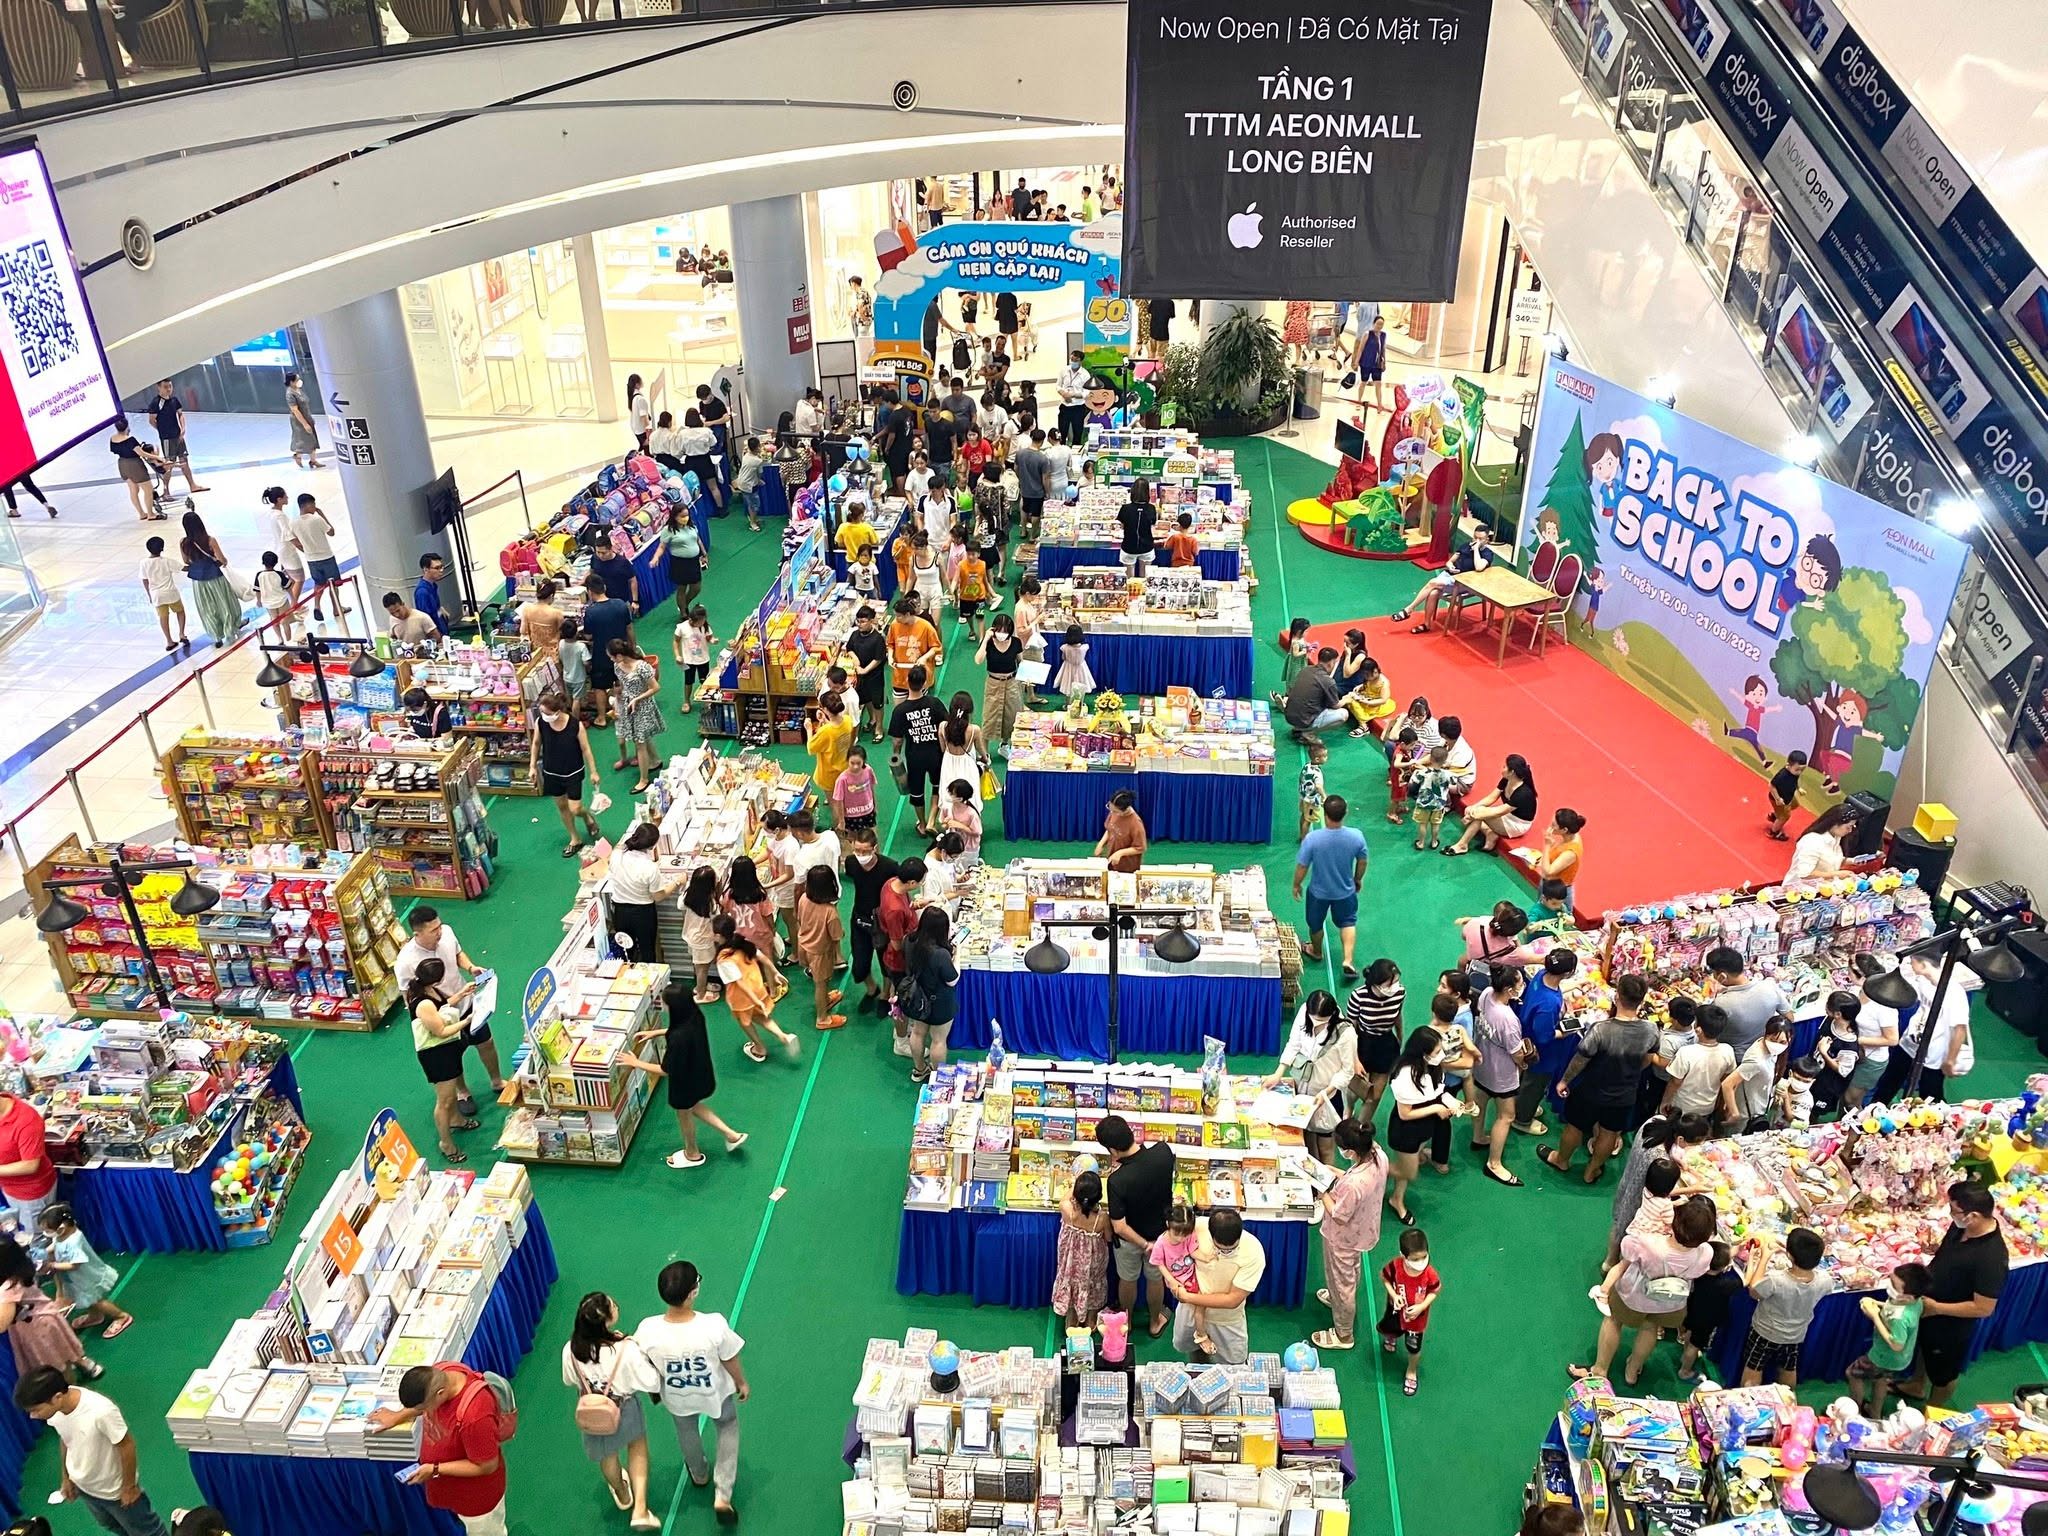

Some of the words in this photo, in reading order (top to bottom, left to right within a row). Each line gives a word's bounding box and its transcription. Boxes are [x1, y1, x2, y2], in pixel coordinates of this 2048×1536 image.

[1160, 17, 1210, 39] Now
[1218, 17, 1279, 43] Open
[1299, 18, 1330, 40] Đã
[1338, 17, 1370, 40] Có
[1377, 18, 1420, 43] Mặt
[1428, 18, 1459, 44] Tại
[1258, 65, 1334, 100] TẦNG
[1341, 77, 1353, 100] 1
[1726, 53, 1778, 131] digibox
[1841, 44, 1896, 120] digibox
[1185, 113, 1261, 137] TTTM
[1267, 114, 1422, 138] AEONMALL
[1227, 150, 1304, 173] LONG
[1310, 145, 1373, 174] BIÊN
[1902, 124, 1928, 161] Now
[1925, 156, 1956, 201] Open
[1783, 135, 1808, 172] Now
[1805, 167, 1834, 214] Open
[1281, 215, 1356, 229] Authorised
[928, 242, 965, 260] CÁM
[969, 241, 992, 256] ƠN
[994, 240, 1029, 258] QUÝ
[1031, 243, 1088, 264] KHÁCH
[1280, 235, 1334, 248] Reseller
[958, 263, 989, 281] HẸN
[994, 263, 1025, 277] GẶP
[793, 324, 809, 338] MUJI
[907, 361, 923, 370] BUS
[1556, 371, 1594, 399] FAHASA
[1983, 426, 2048, 525] digibox
[1622, 442, 1727, 533] BACK
[1738, 497, 1794, 569] TO
[1908, 539, 1936, 560] MALL
[1613, 499, 1782, 635] SCHOOL
[1634, 576, 1658, 602] ngày
[1658, 588, 1688, 618] 12/08
[1696, 612, 1760, 662] 21/08/2022
[1975, 592, 2012, 651] Open
[2005, 672, 2022, 698] TTTM
[1168, 695, 1187, 706] 30
[906, 710, 921, 721] KIND
[921, 708, 931, 717] OF
[911, 717, 931, 728] NASTY
[908, 728, 921, 736] BUT
[921, 724, 937, 734] STILL
[920, 733, 938, 742] COOL
[390, 1138, 408, 1166] 15
[333, 1230, 353, 1260] 15
